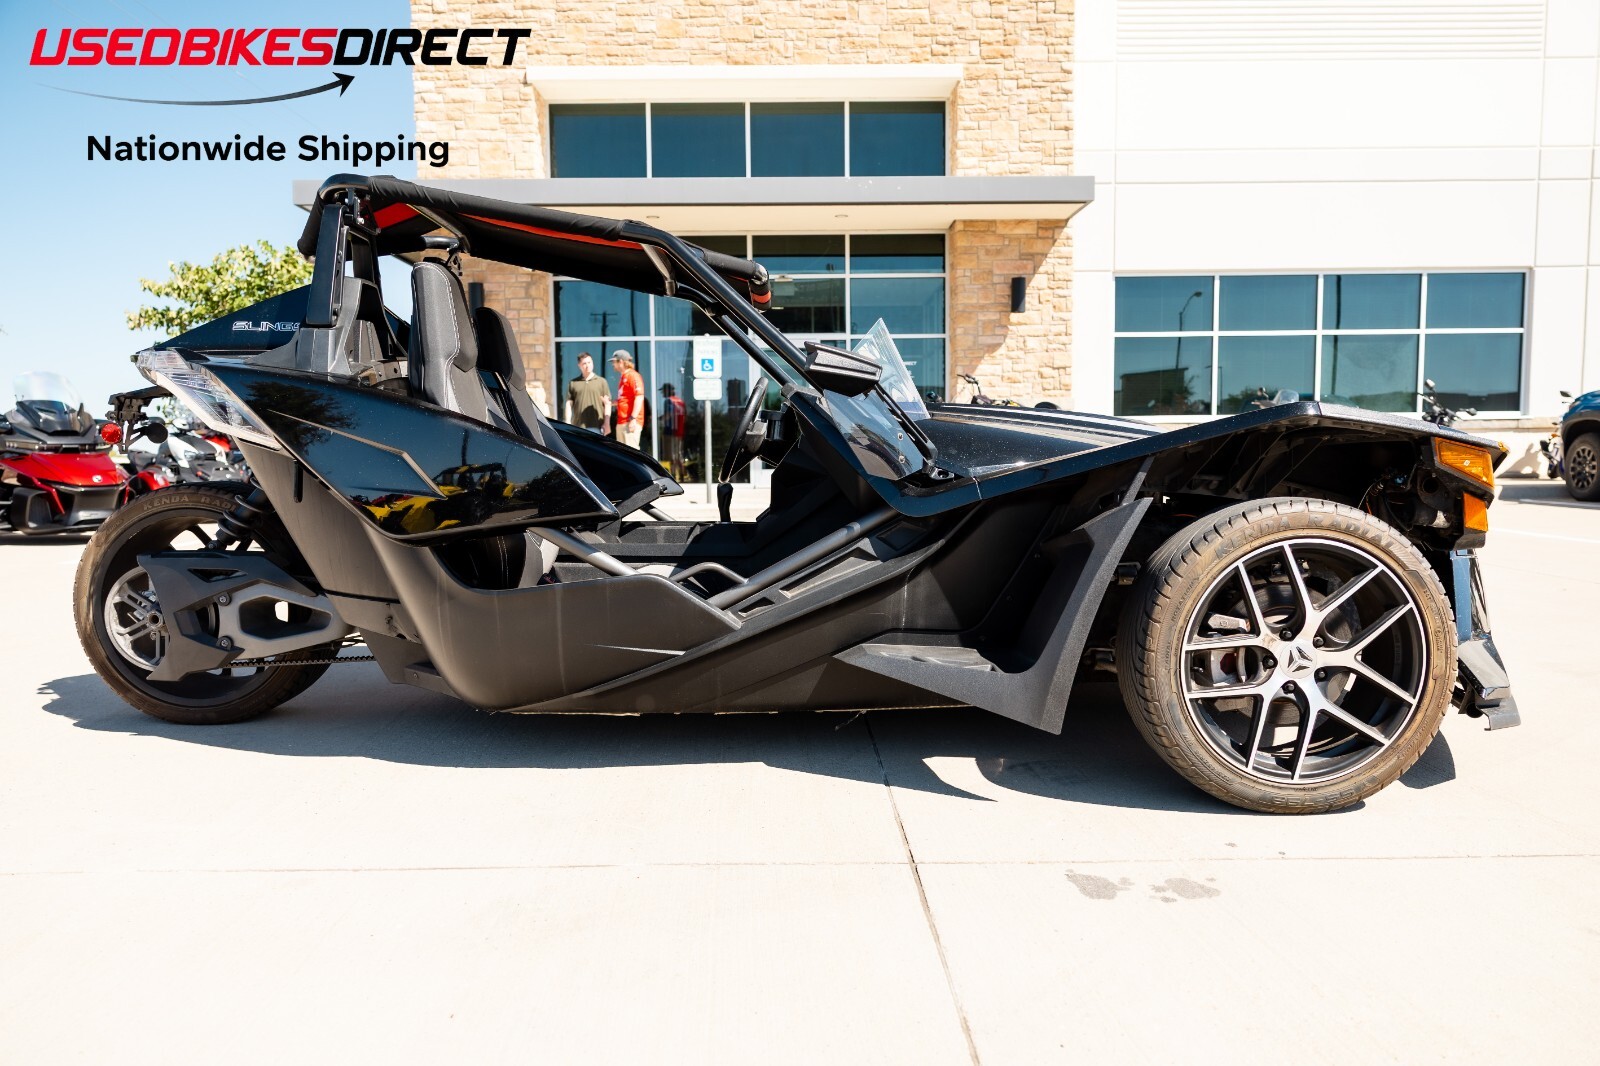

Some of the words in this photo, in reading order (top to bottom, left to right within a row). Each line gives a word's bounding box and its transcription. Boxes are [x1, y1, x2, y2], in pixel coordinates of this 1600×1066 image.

[143, 495, 189, 511] KENDA
[1214, 515, 1291, 559] KENDA
[1308, 513, 1395, 549] RADIAL
